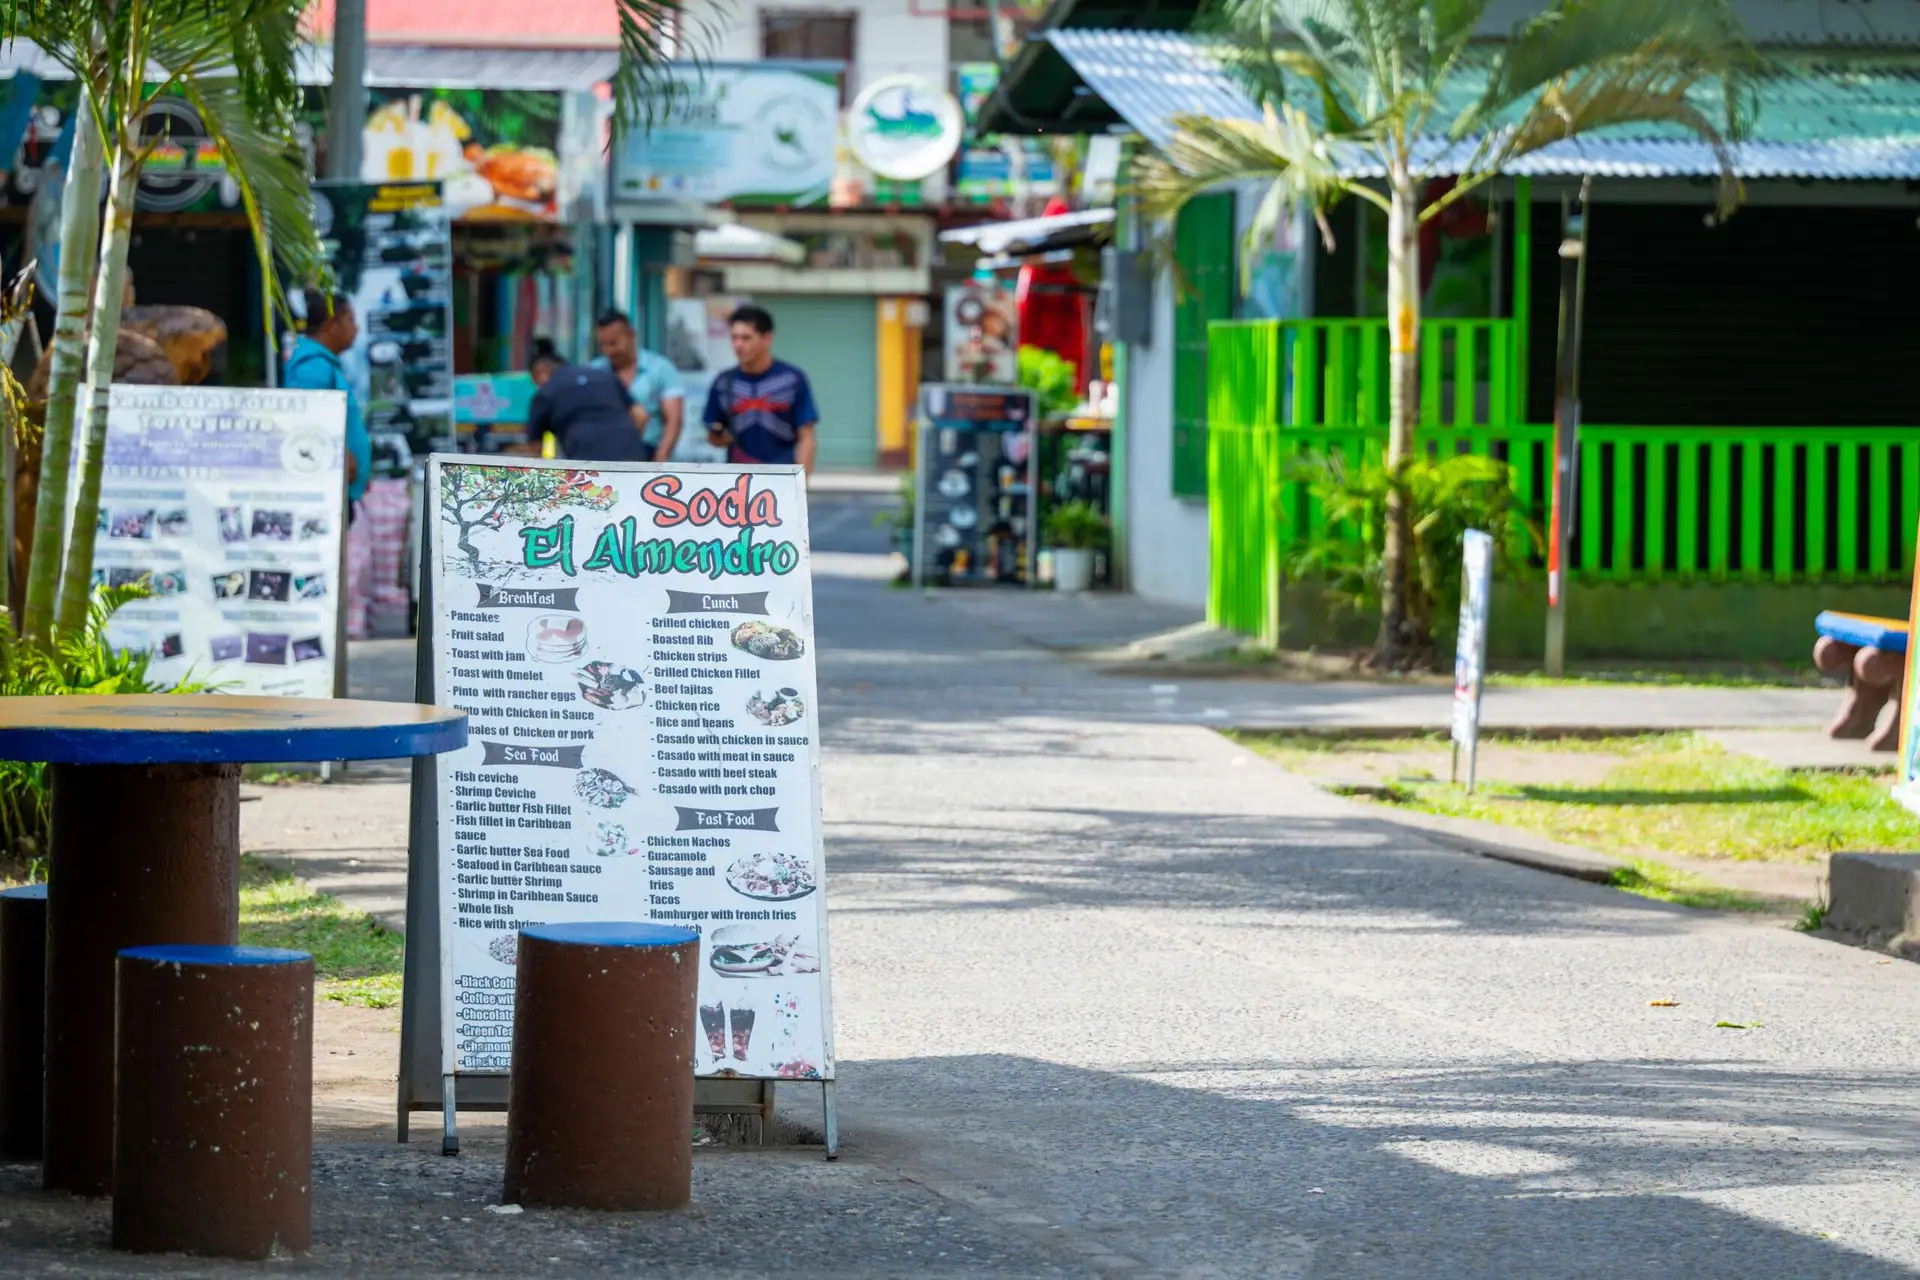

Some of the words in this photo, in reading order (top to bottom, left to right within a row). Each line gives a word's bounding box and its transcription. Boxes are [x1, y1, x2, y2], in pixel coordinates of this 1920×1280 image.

[640, 473, 782, 528] Soda
[519, 514, 578, 577] El
[582, 515, 800, 579] Almendro
[497, 590, 556, 606] Breakfast
[701, 595, 739, 610] Lunch
[451, 610, 500, 623] Pancakes
[652, 618, 687, 629] Grilled
[689, 619, 730, 629] chicken
[451, 630, 474, 641] Fruit
[476, 632, 504, 642] salad
[653, 634, 695, 645] Roasted
[696, 635, 714, 645] Rib
[451, 648, 479, 660] Toast
[481, 650, 503, 660] with
[505, 651, 525, 662] jam
[654, 651, 696, 661] Chicken
[697, 652, 728, 663] strips
[452, 667, 480, 679] Toast
[482, 668, 504, 679] with
[507, 670, 543, 681] Omelet
[654, 668, 689, 678] Grilled
[691, 668, 733, 679] Chicken
[735, 669, 760, 679] Fillet
[453, 686, 479, 697] Pinto
[483, 687, 505, 698] with
[508, 689, 548, 700] rancher
[551, 692, 576, 701] eggs
[655, 684, 678, 694] Beef
[680, 685, 713, 696] fajitas
[656, 700, 697, 711] Chicken
[699, 701, 720, 711] rice
[482, 706, 504, 717] with
[506, 707, 548, 719] Chicken
[550, 709, 560, 719] in
[563, 710, 594, 720] Sauce
[656, 717, 679, 727] Rice
[681, 718, 700, 727] and
[702, 718, 734, 728] beans
[499, 726, 509, 736] of
[514, 726, 555, 738] Chicken
[557, 729, 569, 739] or
[571, 729, 594, 741] pork
[657, 734, 695, 744] Casado
[697, 734, 720, 744] with
[721, 735, 763, 745] chicken
[765, 735, 776, 745] in
[504, 747, 527, 761] Sea
[530, 748, 559, 762] Food
[657, 750, 695, 760] Casado
[697, 751, 720, 761] with
[722, 752, 749, 761] meat
[751, 752, 761, 761] in
[763, 754, 795, 762] sauce
[455, 771, 476, 782] Fish
[478, 773, 518, 783] ceviche
[658, 767, 696, 777] Casado
[698, 767, 721, 777] with
[723, 768, 747, 778] beef
[749, 768, 777, 778] steak
[455, 786, 492, 798] Shrimp
[494, 787, 536, 798] Ceviche
[659, 784, 697, 794] Casado
[699, 784, 722, 794] with
[724, 785, 749, 796] pork
[750, 785, 776, 796] chop
[456, 801, 487, 811] Garlic
[489, 802, 521, 813] butter
[523, 804, 544, 814] Fish
[546, 804, 571, 815] Fillet
[456, 815, 477, 826] Fish
[479, 816, 504, 827] fillet
[505, 817, 516, 827] in
[518, 818, 571, 829] Caribbean
[695, 812, 722, 825] Fast
[724, 812, 755, 825] Food
[455, 831, 486, 841] sauce
[647, 836, 690, 847] Chicken
[692, 837, 731, 847] Nachos
[457, 844, 487, 856] Garlic
[489, 846, 521, 856] butter
[524, 847, 543, 857] Sea
[545, 848, 570, 858] Food
[648, 851, 706, 861] Guacamole
[457, 859, 500, 871] Seafood
[502, 861, 512, 871] in
[514, 861, 568, 872] Caribbean
[570, 864, 601, 873] sauce
[648, 865, 693, 876] Sausage
[695, 866, 715, 876] and
[457, 874, 488, 885] Garlic
[490, 875, 522, 886] butter
[524, 876, 562, 888] Shrimp
[650, 880, 674, 890] fries
[458, 888, 496, 901] Shrimp
[498, 890, 508, 900] in
[509, 890, 564, 902] Caribbean
[566, 892, 599, 902] Sauce
[650, 895, 680, 905] Tacos
[459, 903, 491, 914] Whole
[494, 904, 514, 915] fish
[650, 909, 709, 921] Hamburger
[711, 909, 734, 920] with
[735, 910, 771, 920] french
[772, 910, 796, 920] fries
[459, 918, 482, 928] Rice
[484, 919, 506, 929] with
[461, 975, 492, 988] Black
[492, 977, 516, 989] Coff
[462, 992, 497, 1005] Coffee
[497, 993, 515, 1005] wit
[463, 1024, 496, 1037] Green
[463, 1040, 512, 1052] Chamomi
[464, 1056, 497, 1068] Black
